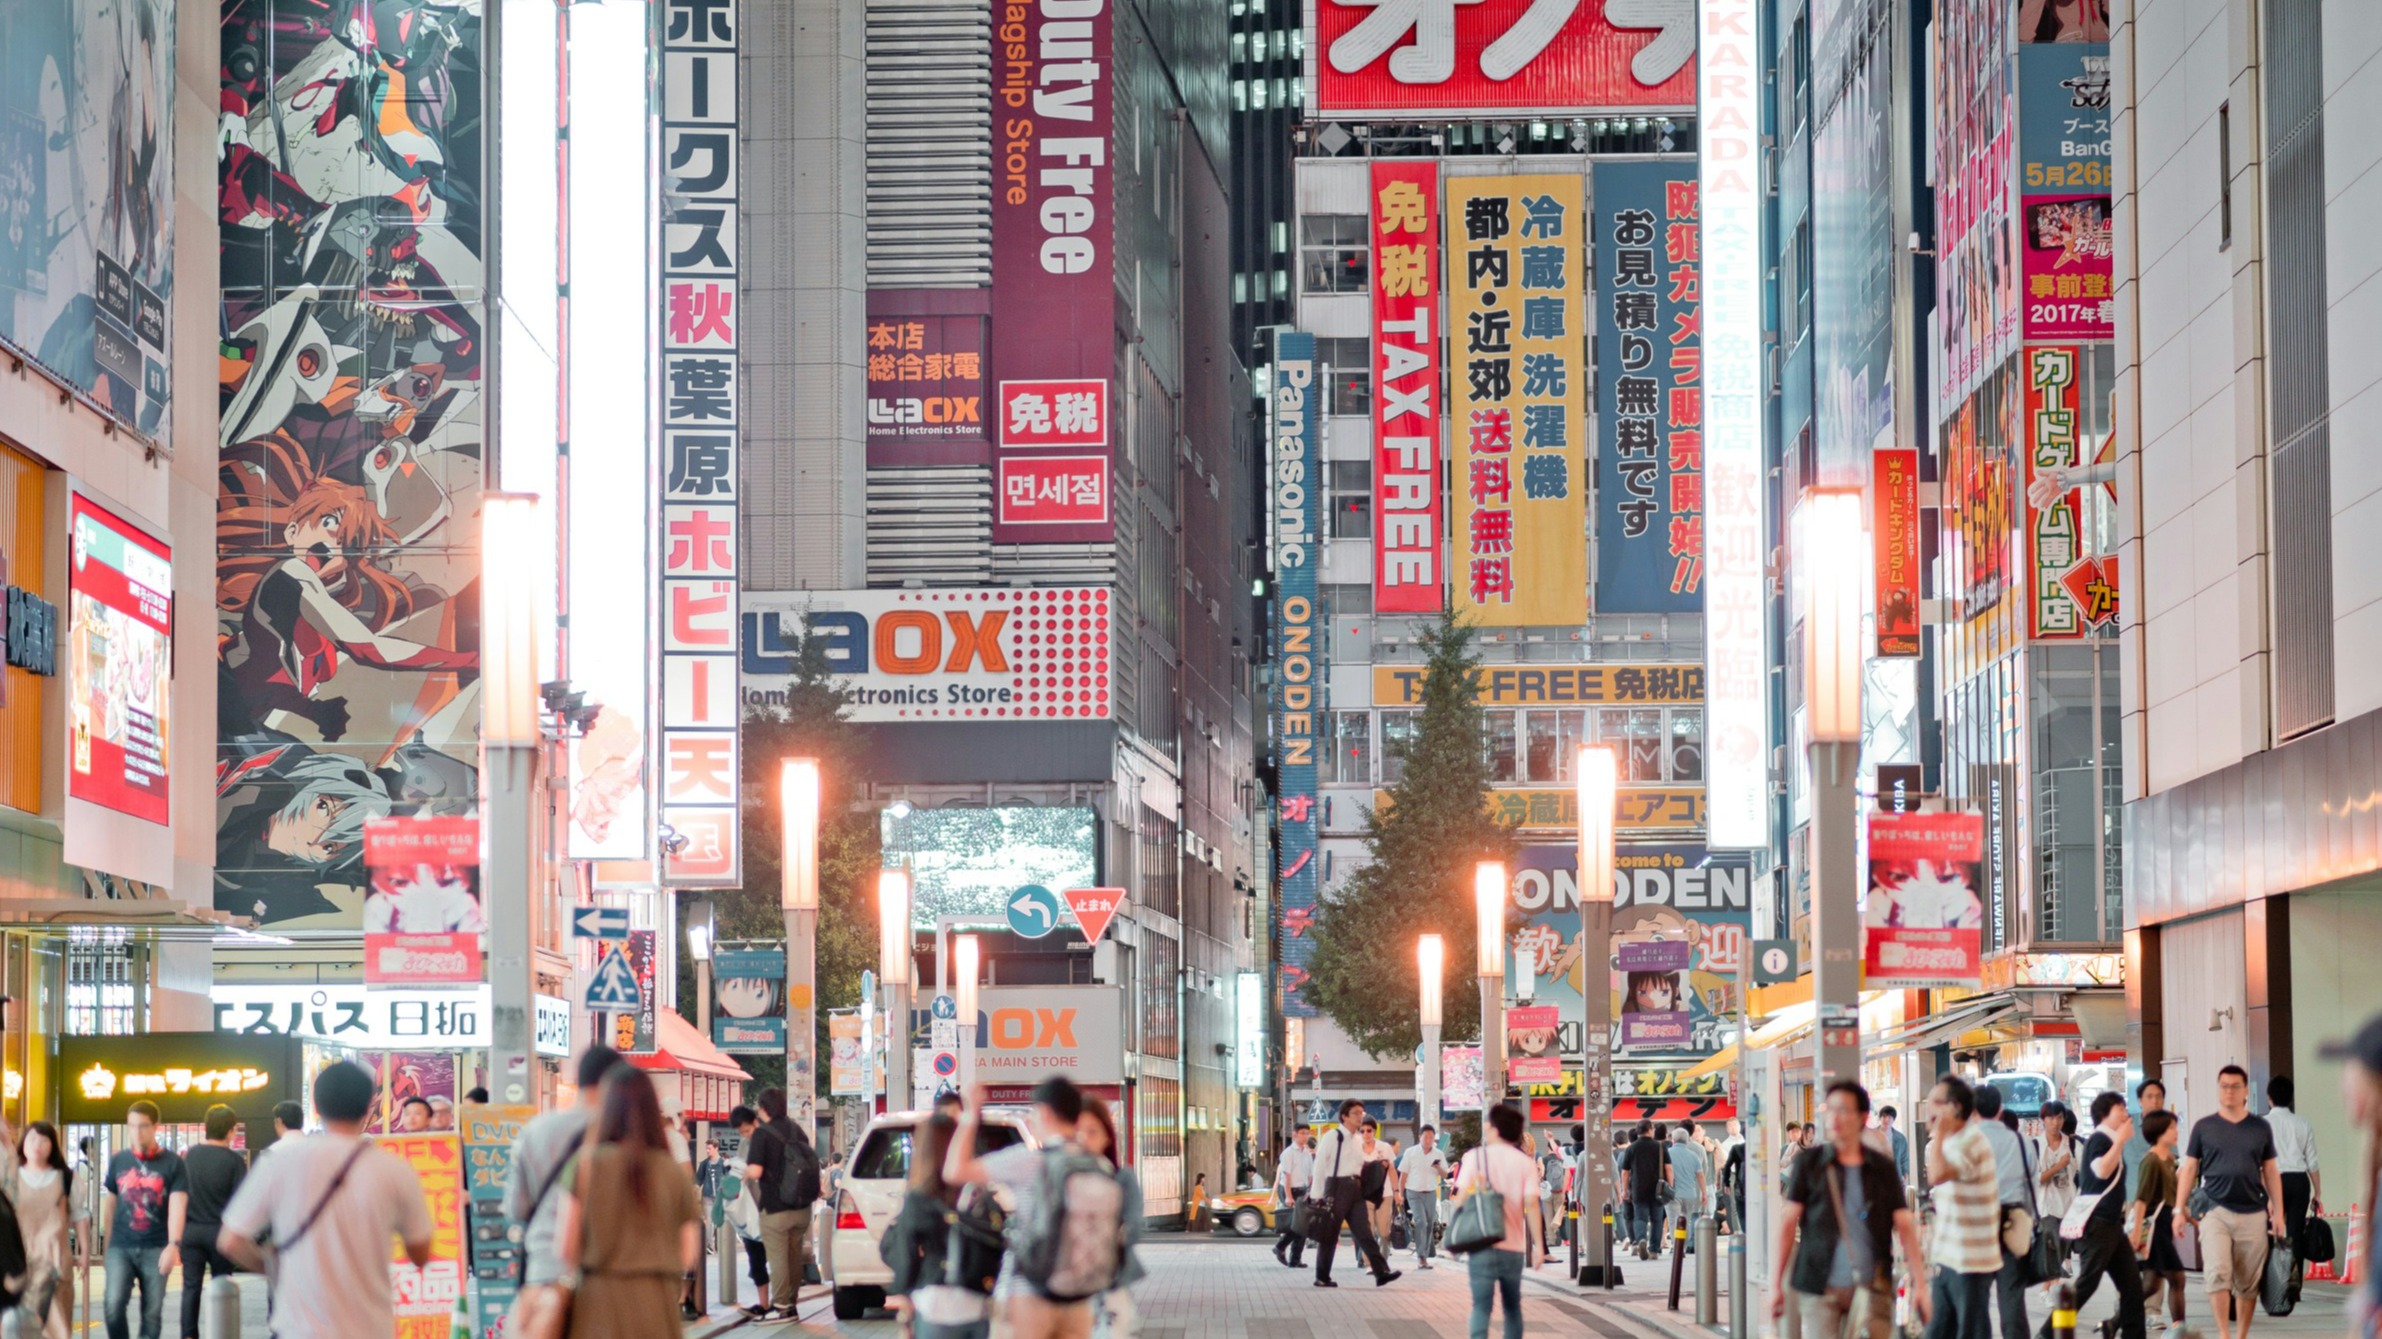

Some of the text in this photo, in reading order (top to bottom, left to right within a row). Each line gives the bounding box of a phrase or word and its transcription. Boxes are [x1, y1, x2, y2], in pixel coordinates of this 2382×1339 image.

[1000, 0, 1033, 205] agship Store
[1707, 0, 1750, 193] KARADA
[1040, 137, 1104, 273] Free
[1379, 180, 1430, 298] 免税
[2030, 275, 2114, 298] 事前登
[868, 322, 924, 350] 本店
[868, 352, 981, 382] 総合家電
[1613, 208, 1659, 538] お見積り無料です
[868, 427, 897, 435] Home
[955, 425, 982, 434] Store
[1009, 393, 1098, 434] 免税
[1279, 360, 1312, 568] Panasonic
[1381, 307, 1433, 587] TAX FREE
[1007, 473, 1100, 506] 면세점
[1888, 471, 1905, 584] カードキングダム
[845, 684, 939, 705] ctronics
[948, 683, 1011, 704] Store
[1283, 596, 1312, 765] ONODEN
[1491, 671, 1603, 700] FREE
[1894, 778, 1905, 813] KIBA
[1664, 853, 1684, 867] to
[1075, 899, 1112, 912] 止まれ
[992, 1057, 1024, 1067] MAIN
[1032, 1056, 1078, 1067] STORE
[992, 1090, 1017, 1098] DUTY
